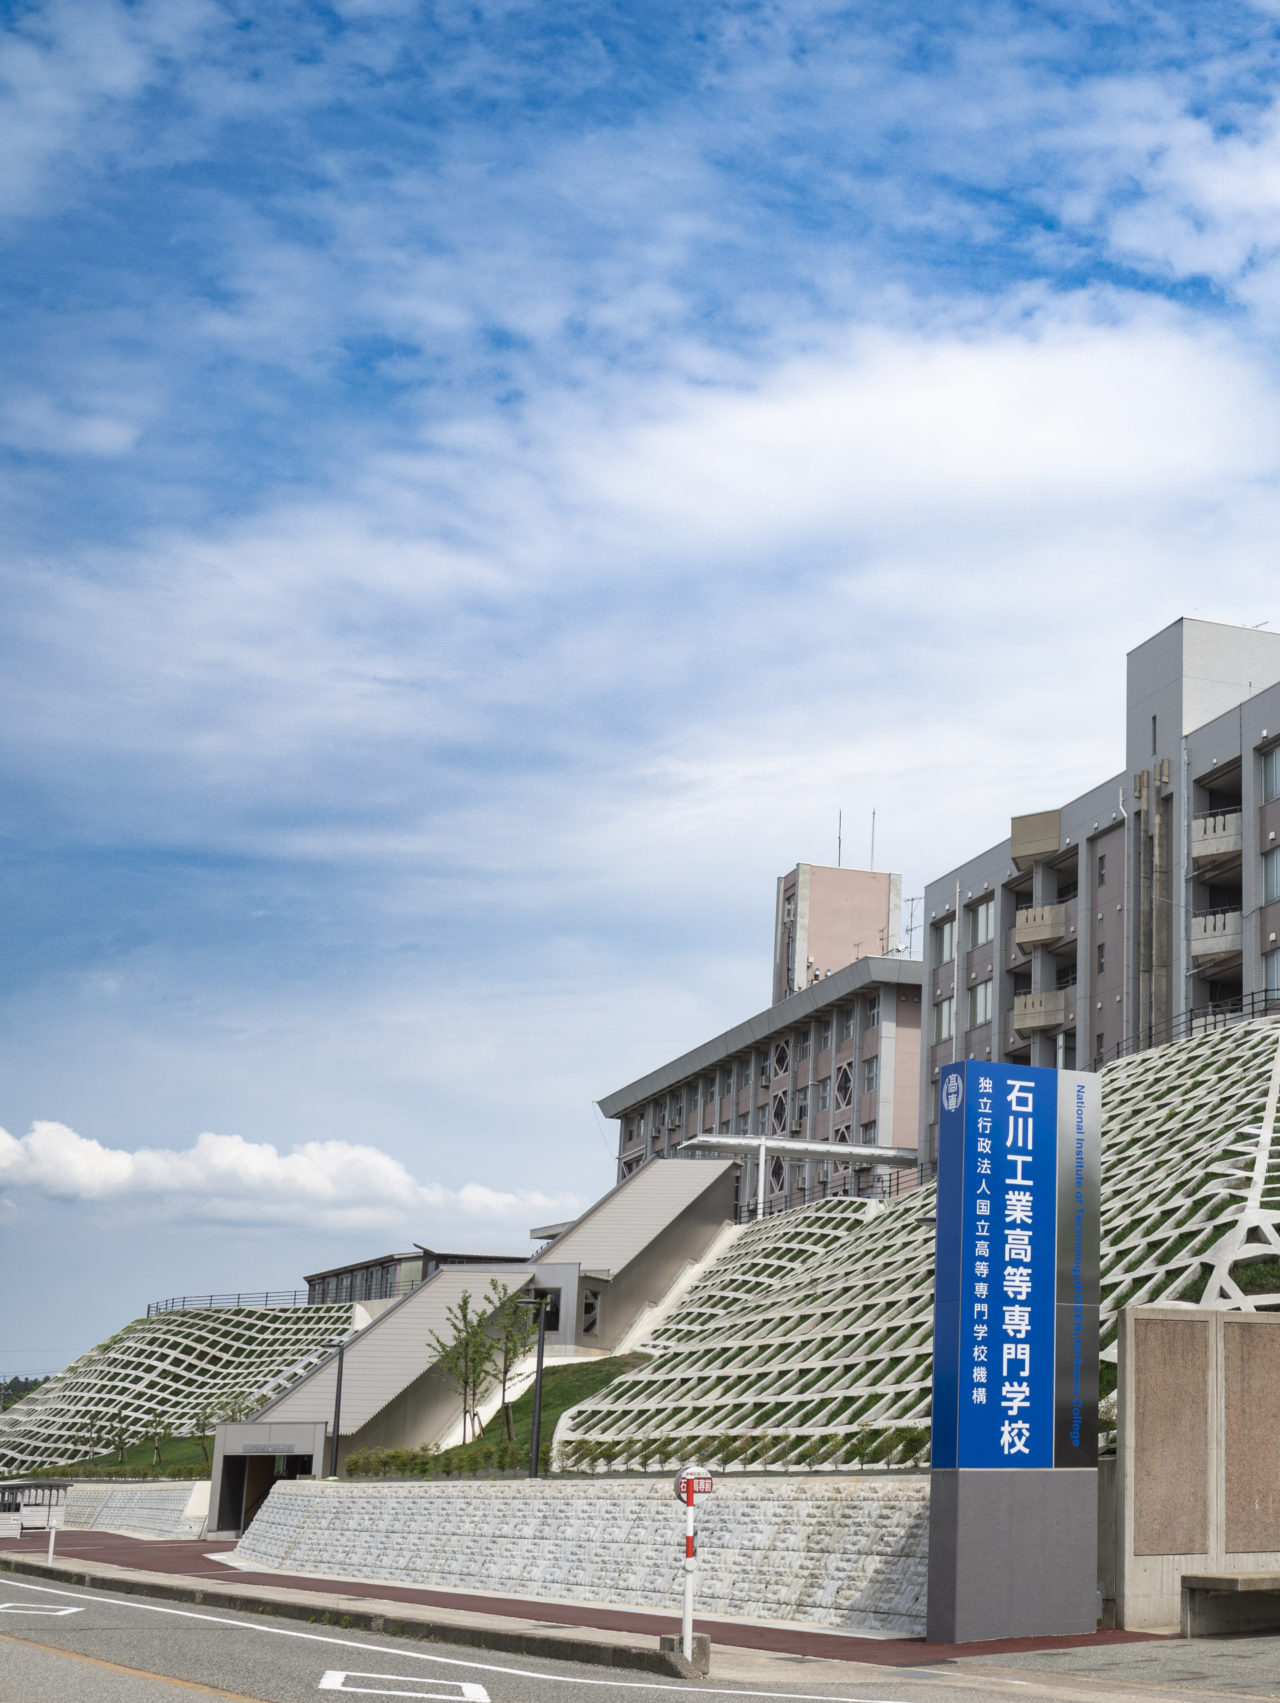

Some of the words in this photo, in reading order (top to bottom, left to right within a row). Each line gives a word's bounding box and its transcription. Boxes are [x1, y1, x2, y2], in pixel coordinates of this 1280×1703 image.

[1076, 1084, 1086, 1135] National
[1075, 1138, 1085, 1188] Institute
[1074, 1191, 1084, 1204] of
[972, 1076, 993, 1405] 独立行政法人国立高等専門学校機構
[1000, 1079, 1035, 1455] 石川工業高等専門学校
[1070, 1398, 1082, 1447] College
